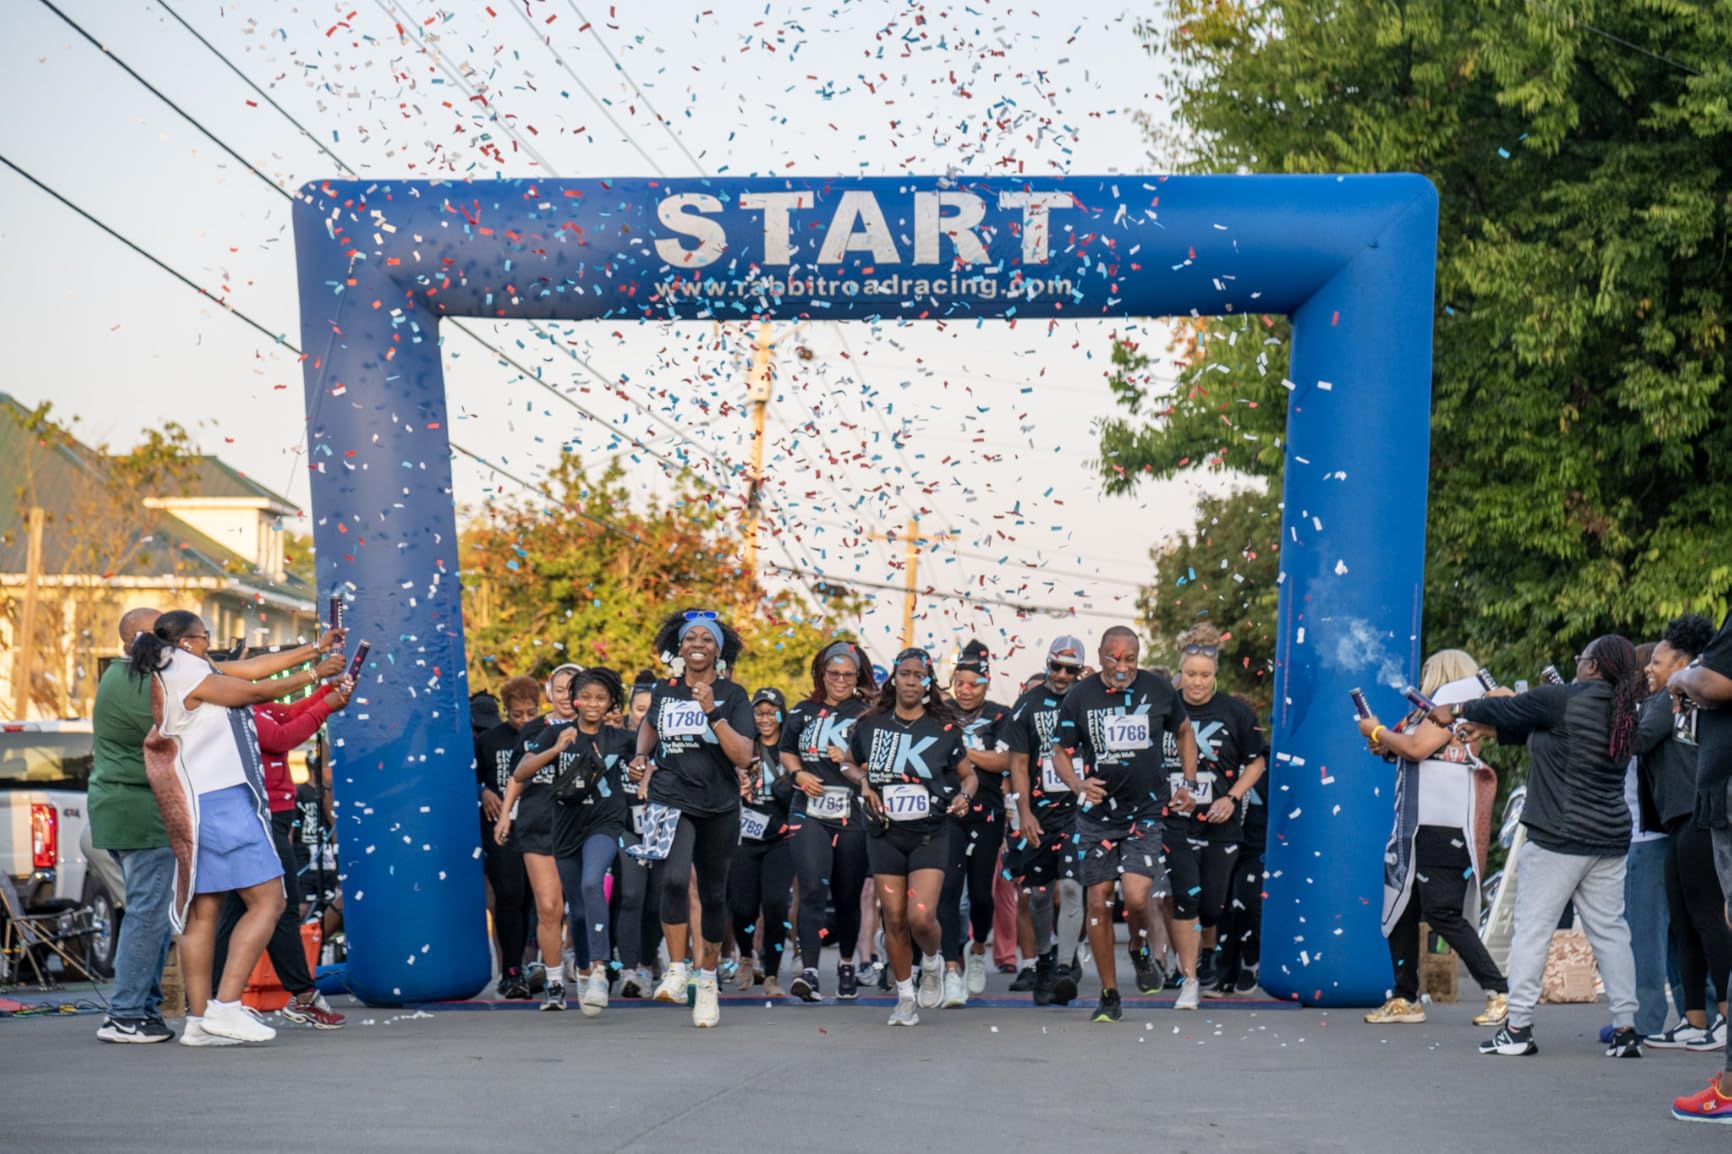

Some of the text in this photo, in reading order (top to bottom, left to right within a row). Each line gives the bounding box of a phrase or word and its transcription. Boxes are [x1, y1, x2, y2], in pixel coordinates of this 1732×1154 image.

[654, 191, 1073, 268] START
[653, 274, 1073, 298] www.rabbitroadracing.com
[666, 711, 705, 728] 1780
[892, 733, 939, 779] K
[888, 795, 927, 812] 1776
[741, 816, 764, 836] 768
